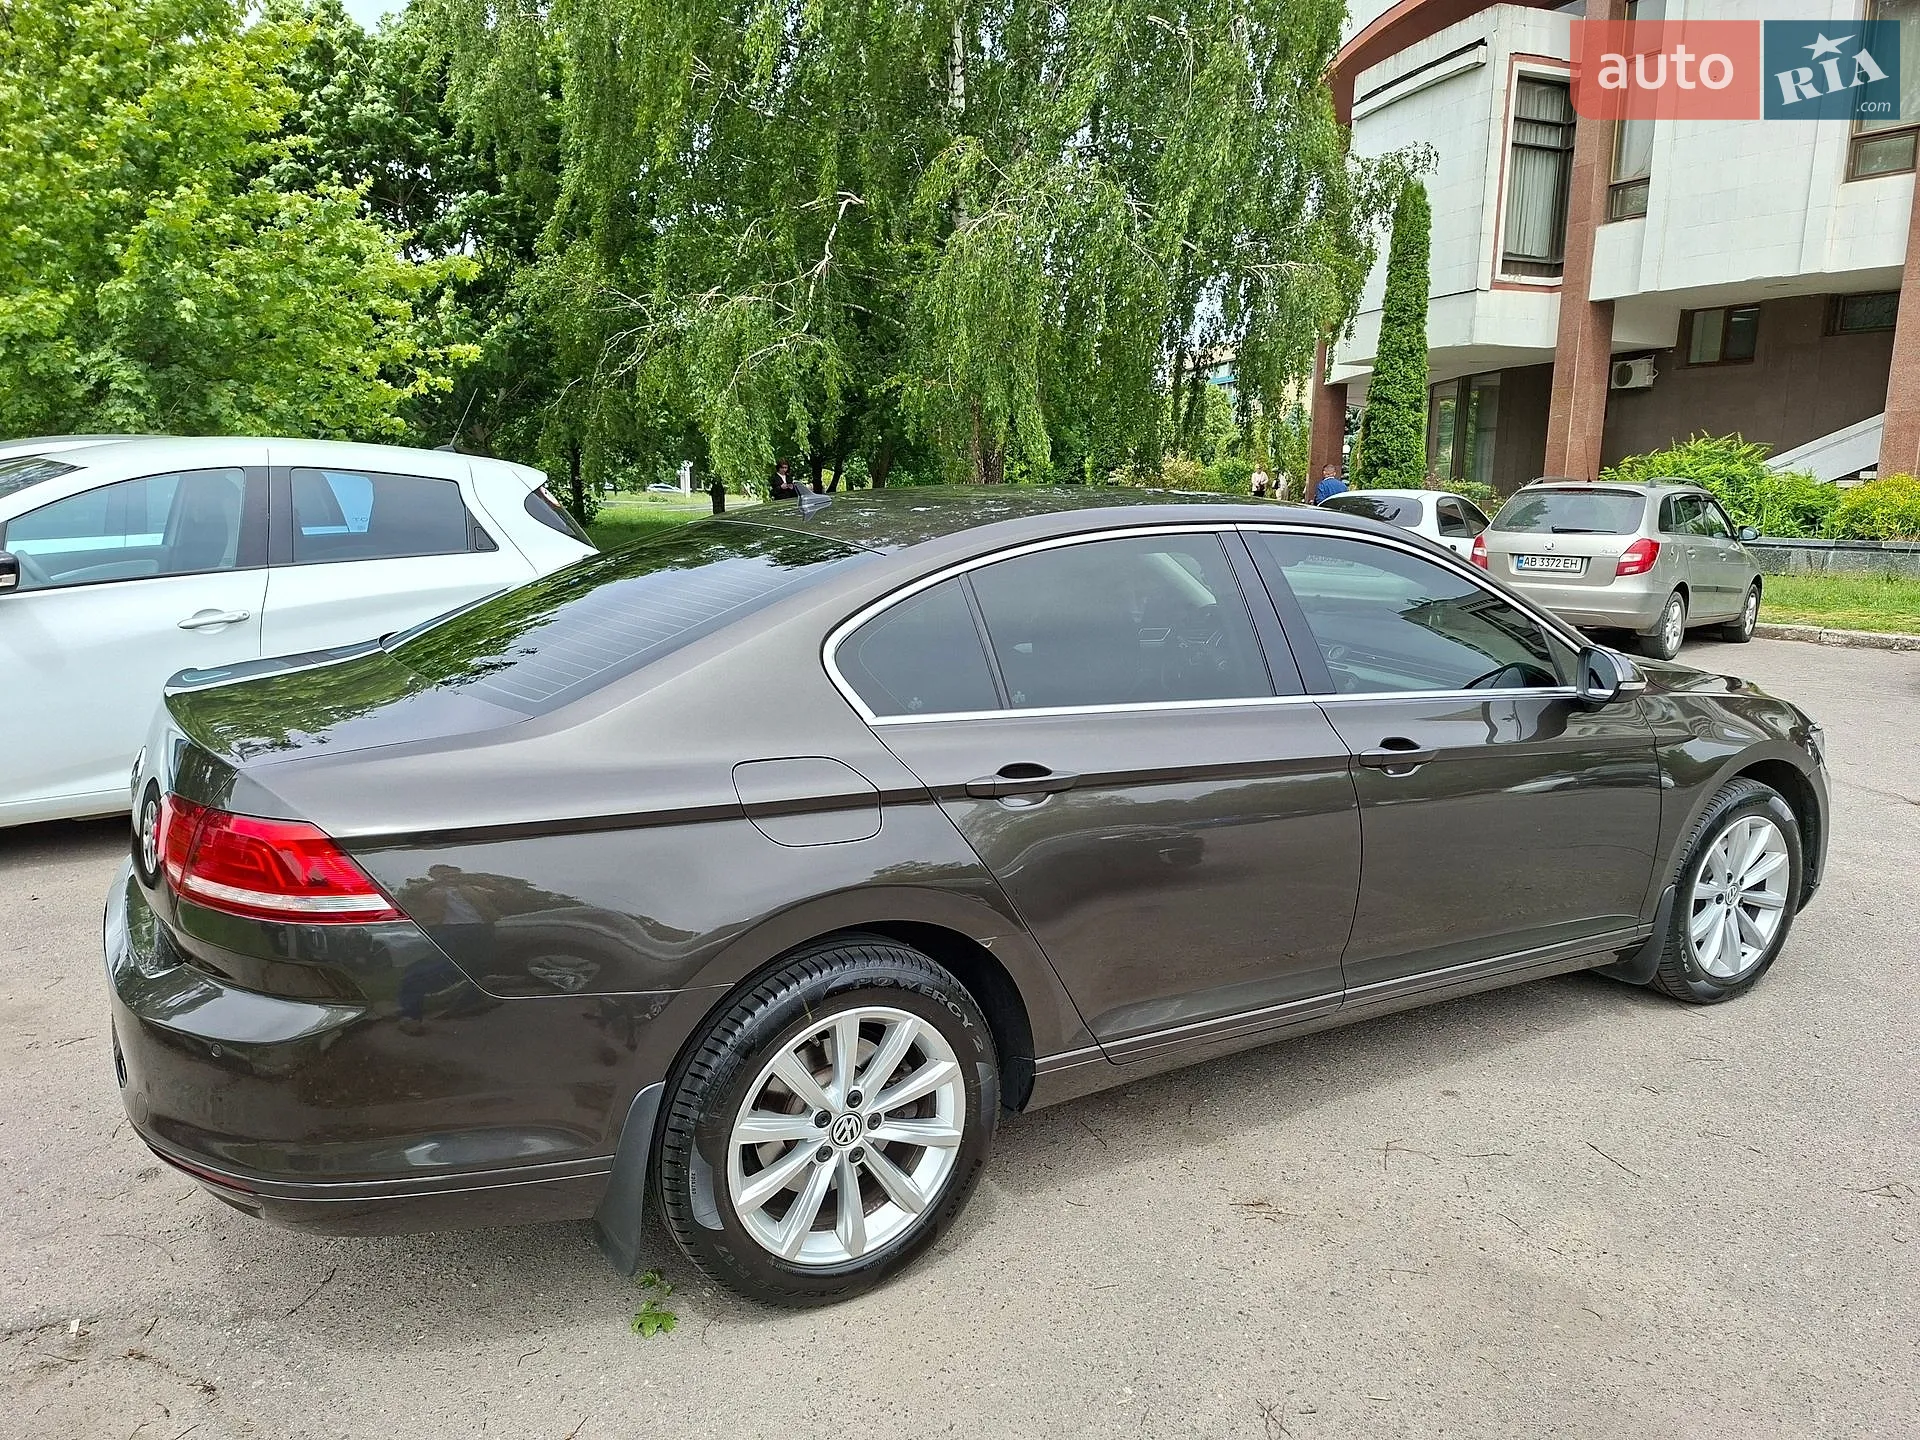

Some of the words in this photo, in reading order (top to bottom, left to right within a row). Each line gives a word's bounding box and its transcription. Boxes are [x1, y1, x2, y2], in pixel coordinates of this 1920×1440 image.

[1523, 556, 1537, 567] AB
[1539, 557, 1561, 568] 3372
[1563, 558, 1578, 569] EH
